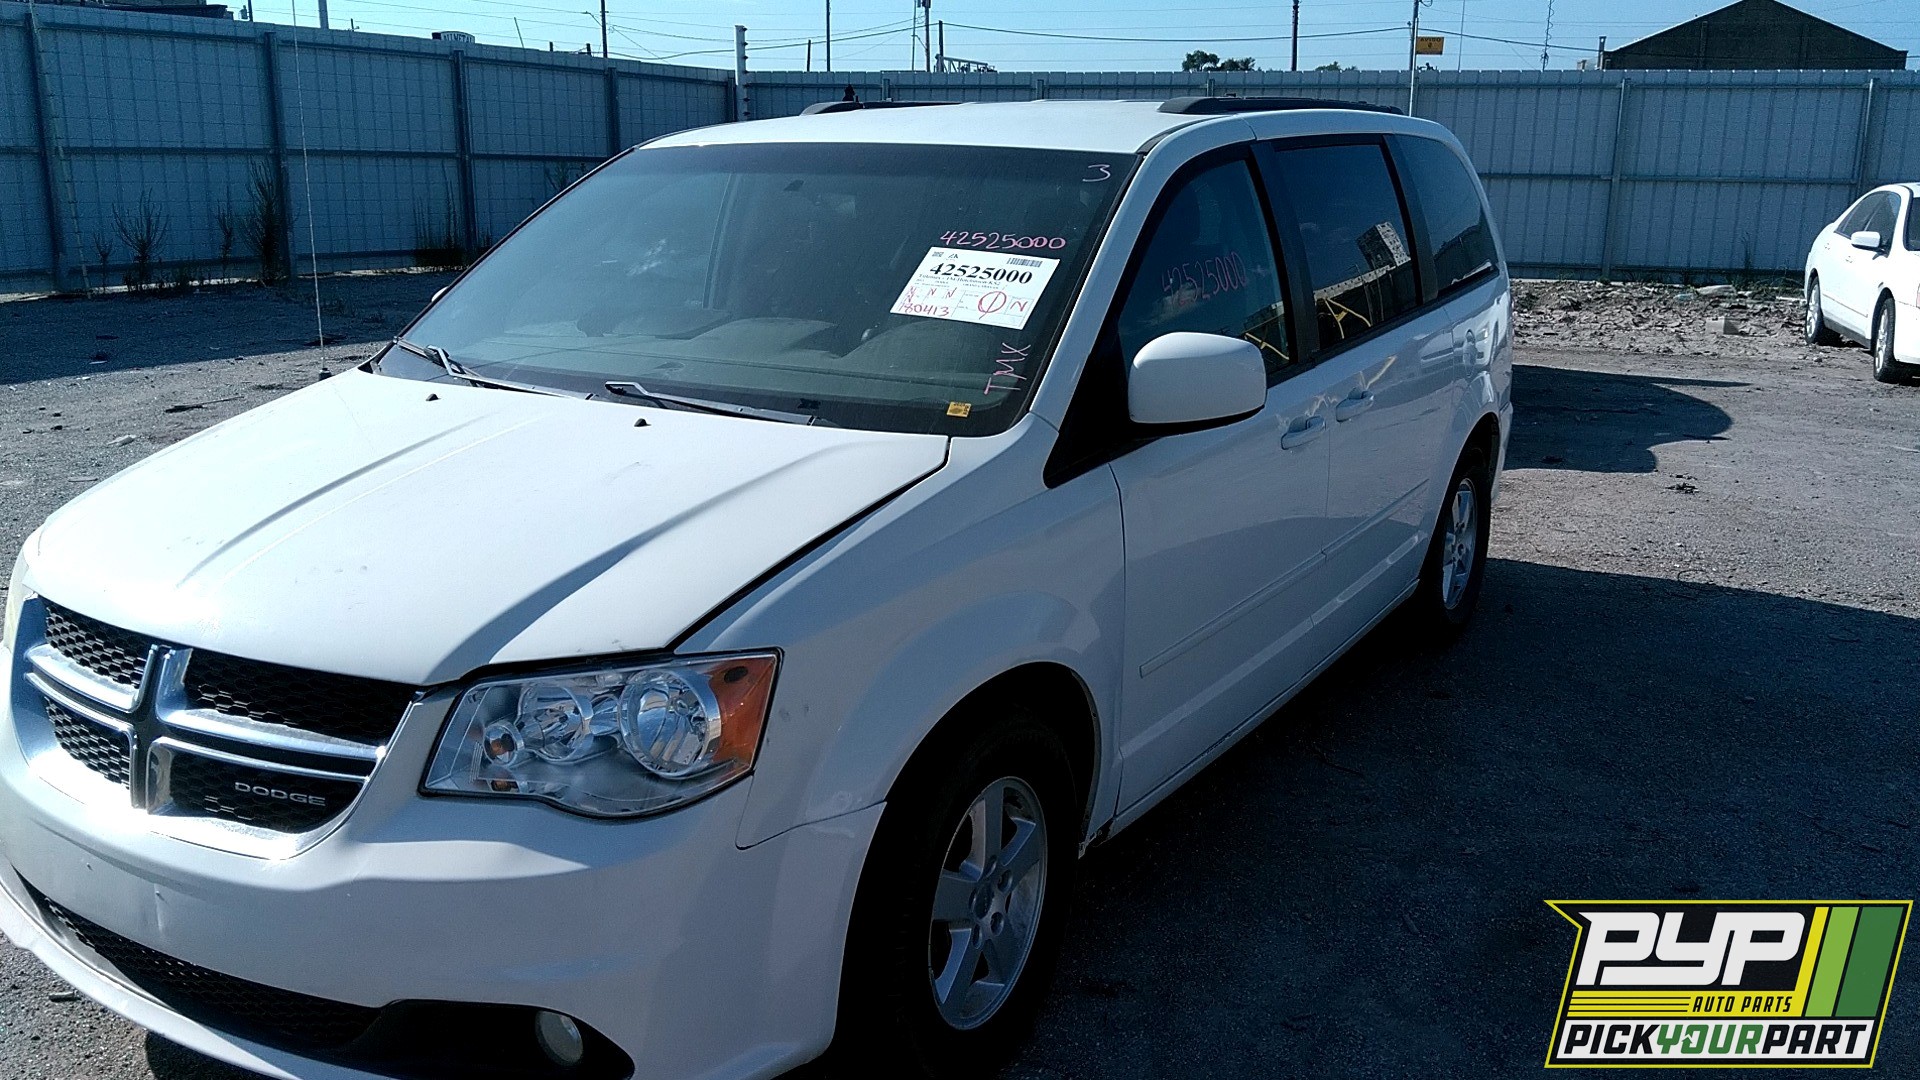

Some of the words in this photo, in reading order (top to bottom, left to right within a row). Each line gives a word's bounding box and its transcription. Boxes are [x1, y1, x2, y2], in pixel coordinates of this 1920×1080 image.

[1082, 164, 1111, 182] 3
[940, 231, 1066, 249] 42525000
[930, 263, 1033, 284] 42525000
[1162, 251, 1247, 305] 42525000
[235, 782, 326, 806] DODGE
